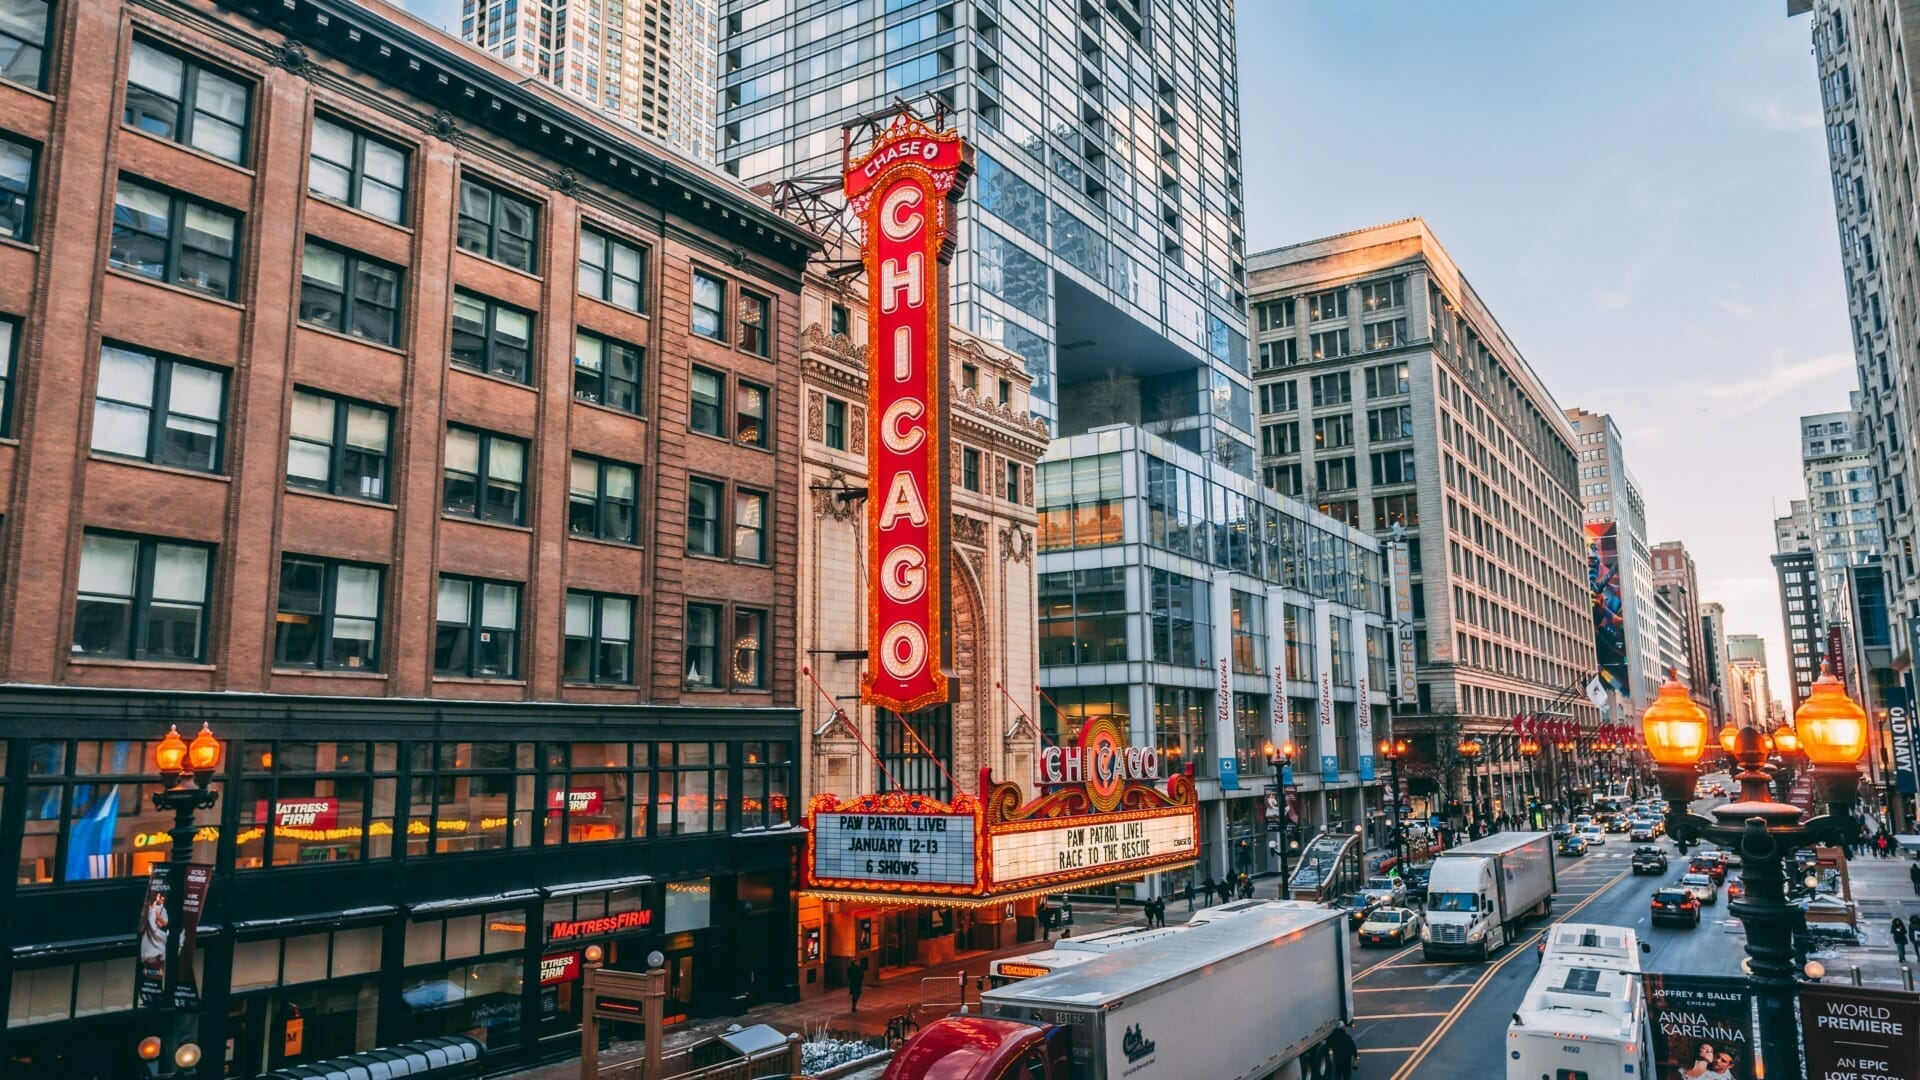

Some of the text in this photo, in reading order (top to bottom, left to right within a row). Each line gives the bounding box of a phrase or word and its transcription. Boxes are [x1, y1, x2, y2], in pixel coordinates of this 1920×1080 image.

[864, 141, 921, 178] CHASE
[879, 185, 928, 681] CHICAGO
[1395, 545, 1417, 702] JOFFREY BALLET
[1219, 656, 1231, 721] Walgreens
[1273, 665, 1286, 725] Walgreens
[1321, 672, 1332, 726] Walgreens
[1360, 678, 1369, 728] Walgreens
[1890, 707, 1912, 772] OLD NAVY
[1041, 745, 1158, 782] CHICAGO
[555, 791, 597, 801] MTTRESS
[281, 813, 316, 825] FIRM
[840, 816, 947, 832] PAW PATROL LIVE!
[848, 837, 938, 854] JANUARY 12-13
[1067, 822, 1143, 847] PAW PATROL LIVE!
[1060, 839, 1150, 869] RACE TO THE RESCUE
[866, 859, 919, 875] 6 SHOWS
[1653, 989, 1742, 1000] JOFFREY BALLET
[1659, 1011, 1708, 1026] ANNA
[1826, 1001, 1890, 1020] WORLD
[1660, 1023, 1746, 1042] KARENINA
[1818, 1015, 1903, 1036] PREMIERE
[1836, 1057, 1888, 1071] AN EPIC
